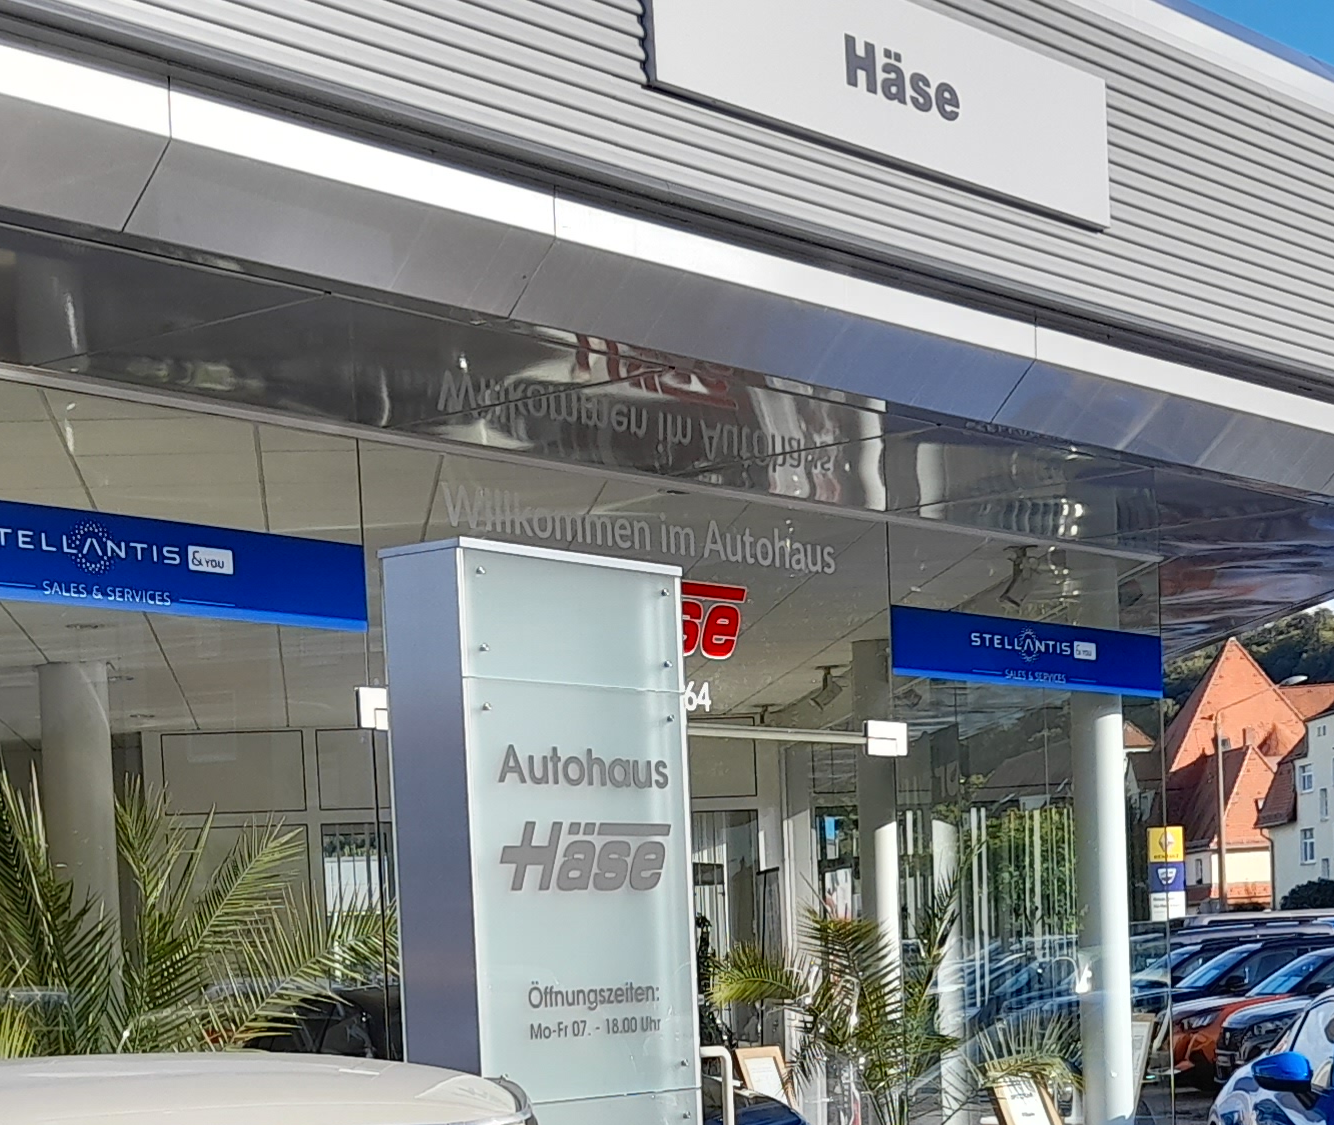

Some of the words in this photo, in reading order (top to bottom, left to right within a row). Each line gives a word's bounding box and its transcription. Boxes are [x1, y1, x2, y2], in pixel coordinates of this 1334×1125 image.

[844, 33, 960, 121] Häse
[441, 482, 651, 551] Willkommen
[660, 513, 696, 558] im
[702, 520, 837, 575] Autohaus
[43, 581, 87, 598] SALES
[93, 586, 102, 599] &
[107, 588, 171, 606] SERVICES
[970, 632, 1071, 655] STELLANTIS
[1005, 668, 1026, 681] SALES
[498, 743, 669, 789] Autohaus
[499, 821, 672, 891] Häse
[528, 980, 660, 1011] Öffnungszeiten:
[530, 1022, 568, 1040] Mo-Fr
[572, 1020, 591, 1037] 07.
[606, 1016, 638, 1034] 18.00
[641, 1016, 661, 1032] Uhr
